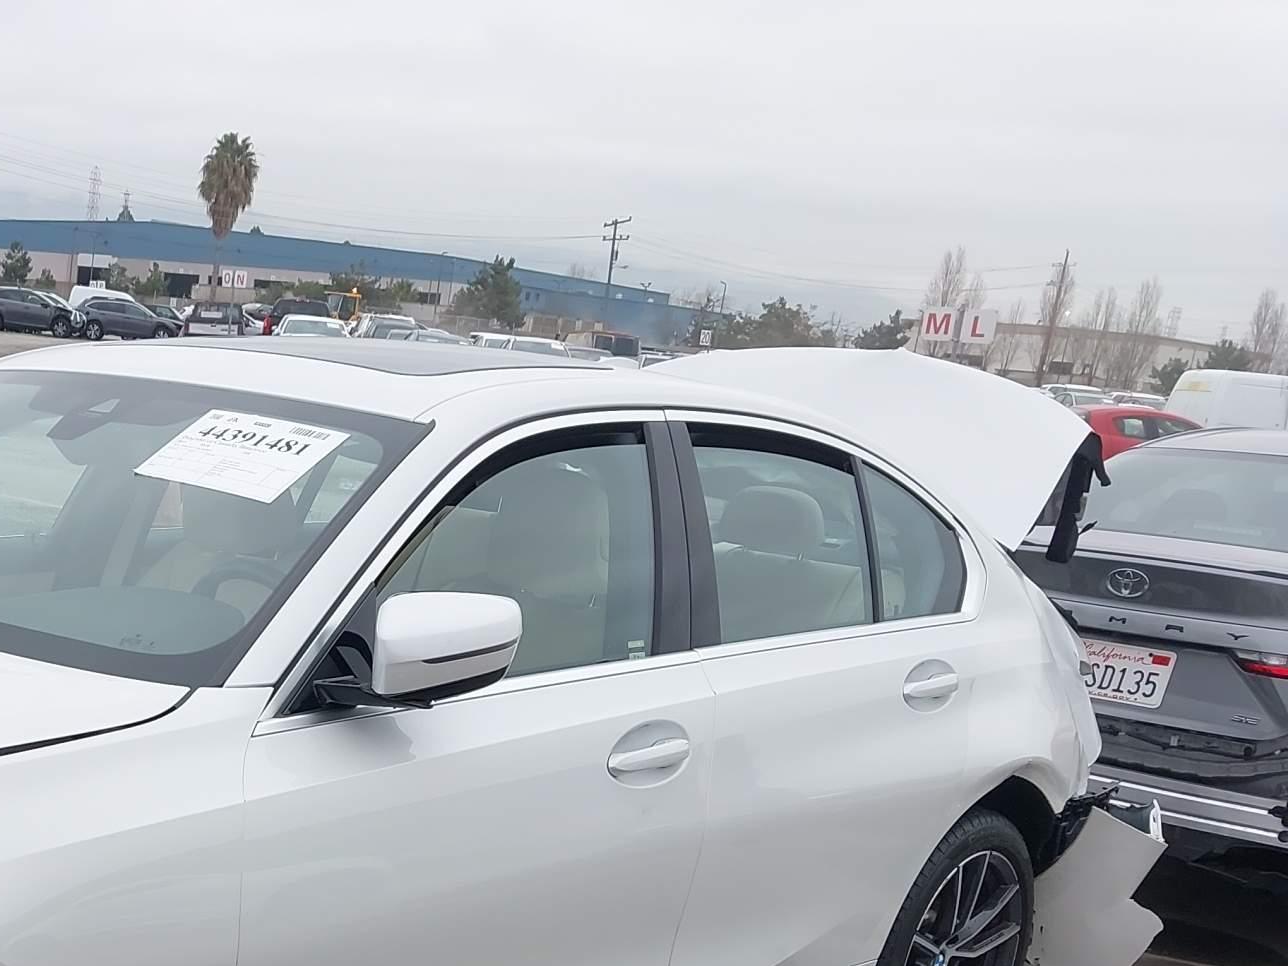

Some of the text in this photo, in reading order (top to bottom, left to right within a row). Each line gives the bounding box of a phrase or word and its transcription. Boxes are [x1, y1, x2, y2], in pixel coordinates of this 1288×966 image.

[701, 331, 711, 344] 20
[924, 312, 985, 338] M L
[197, 425, 312, 456] 44391481
[1082, 641, 1152, 665] California
[1084, 662, 1160, 698] SD135
